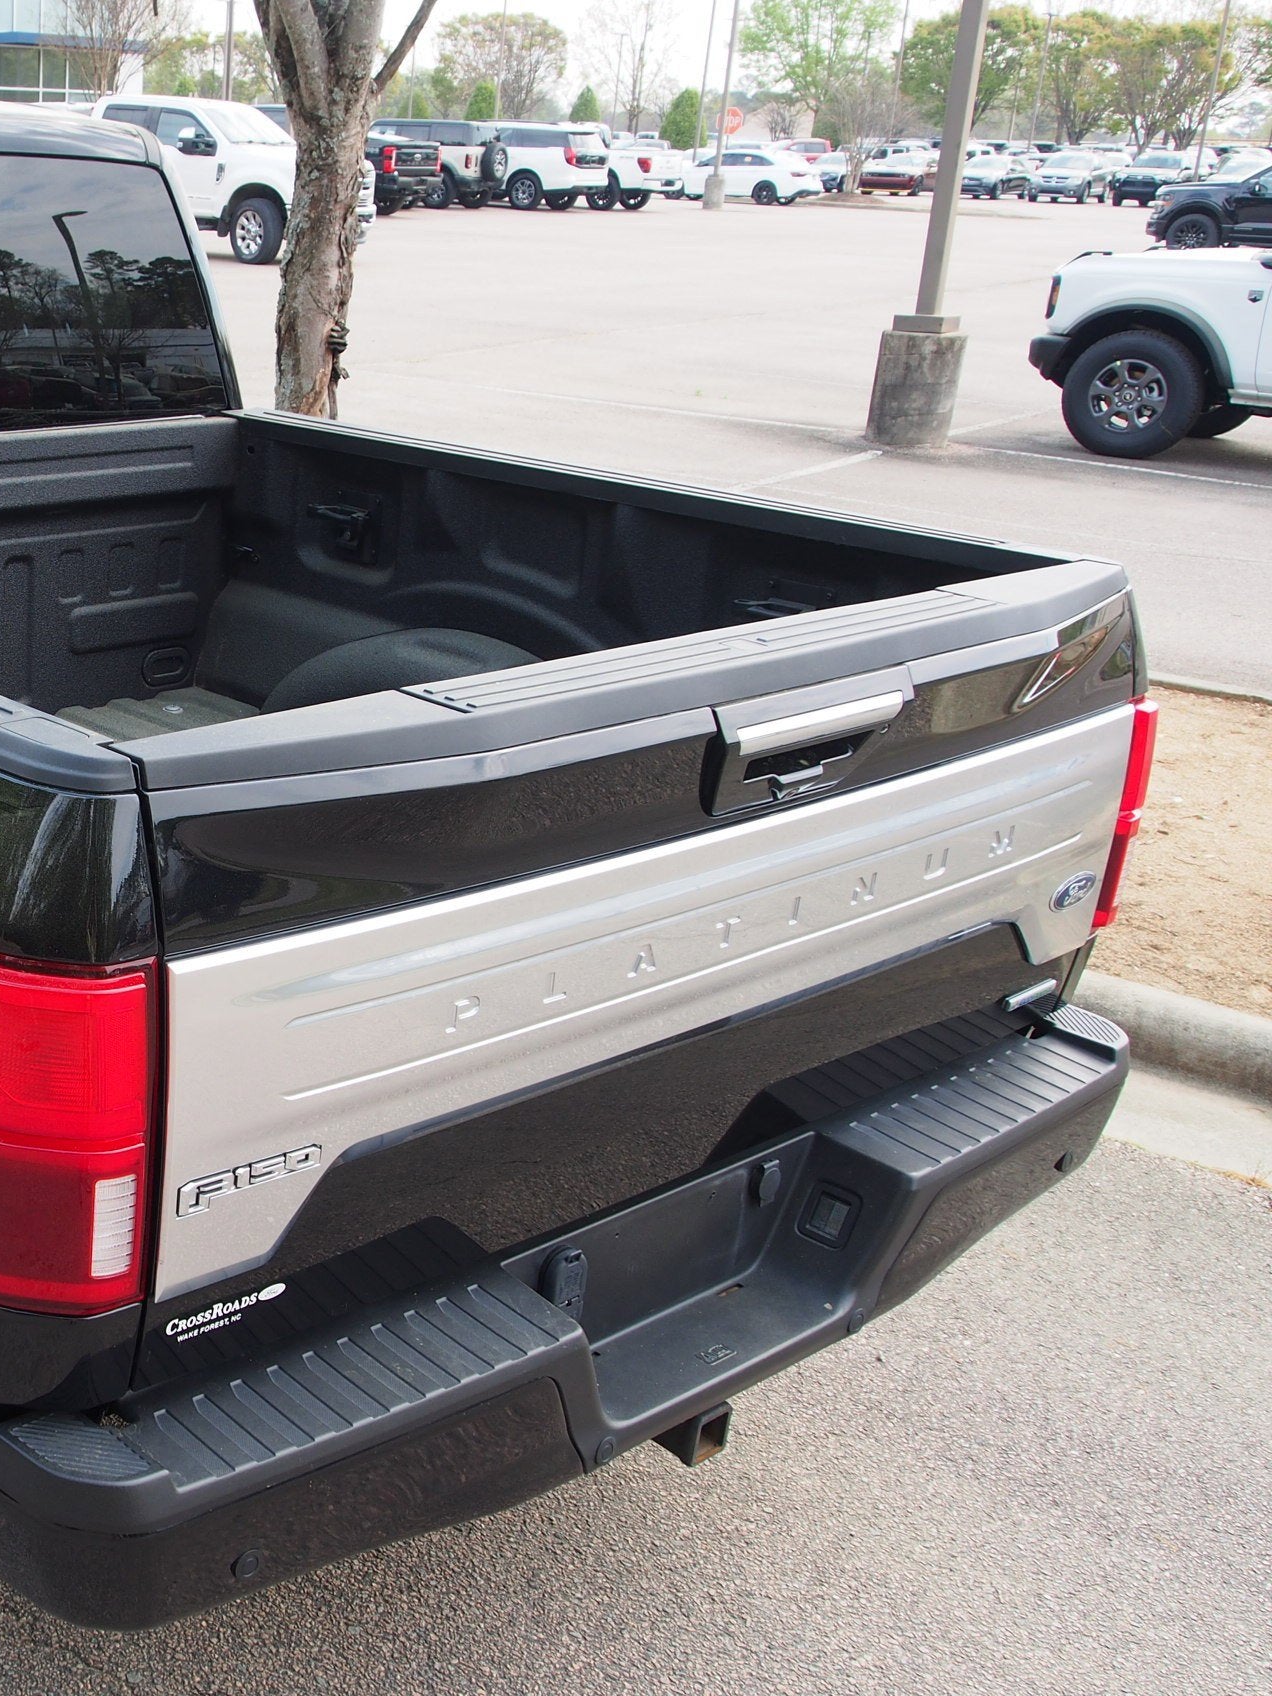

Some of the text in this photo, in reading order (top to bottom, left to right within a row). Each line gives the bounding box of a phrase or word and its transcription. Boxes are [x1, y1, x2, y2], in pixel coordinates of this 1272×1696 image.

[445, 825, 1016, 1033] PLATINUM
[177, 1328, 199, 1342] WAKE
[230, 1313, 242, 1323] NC
